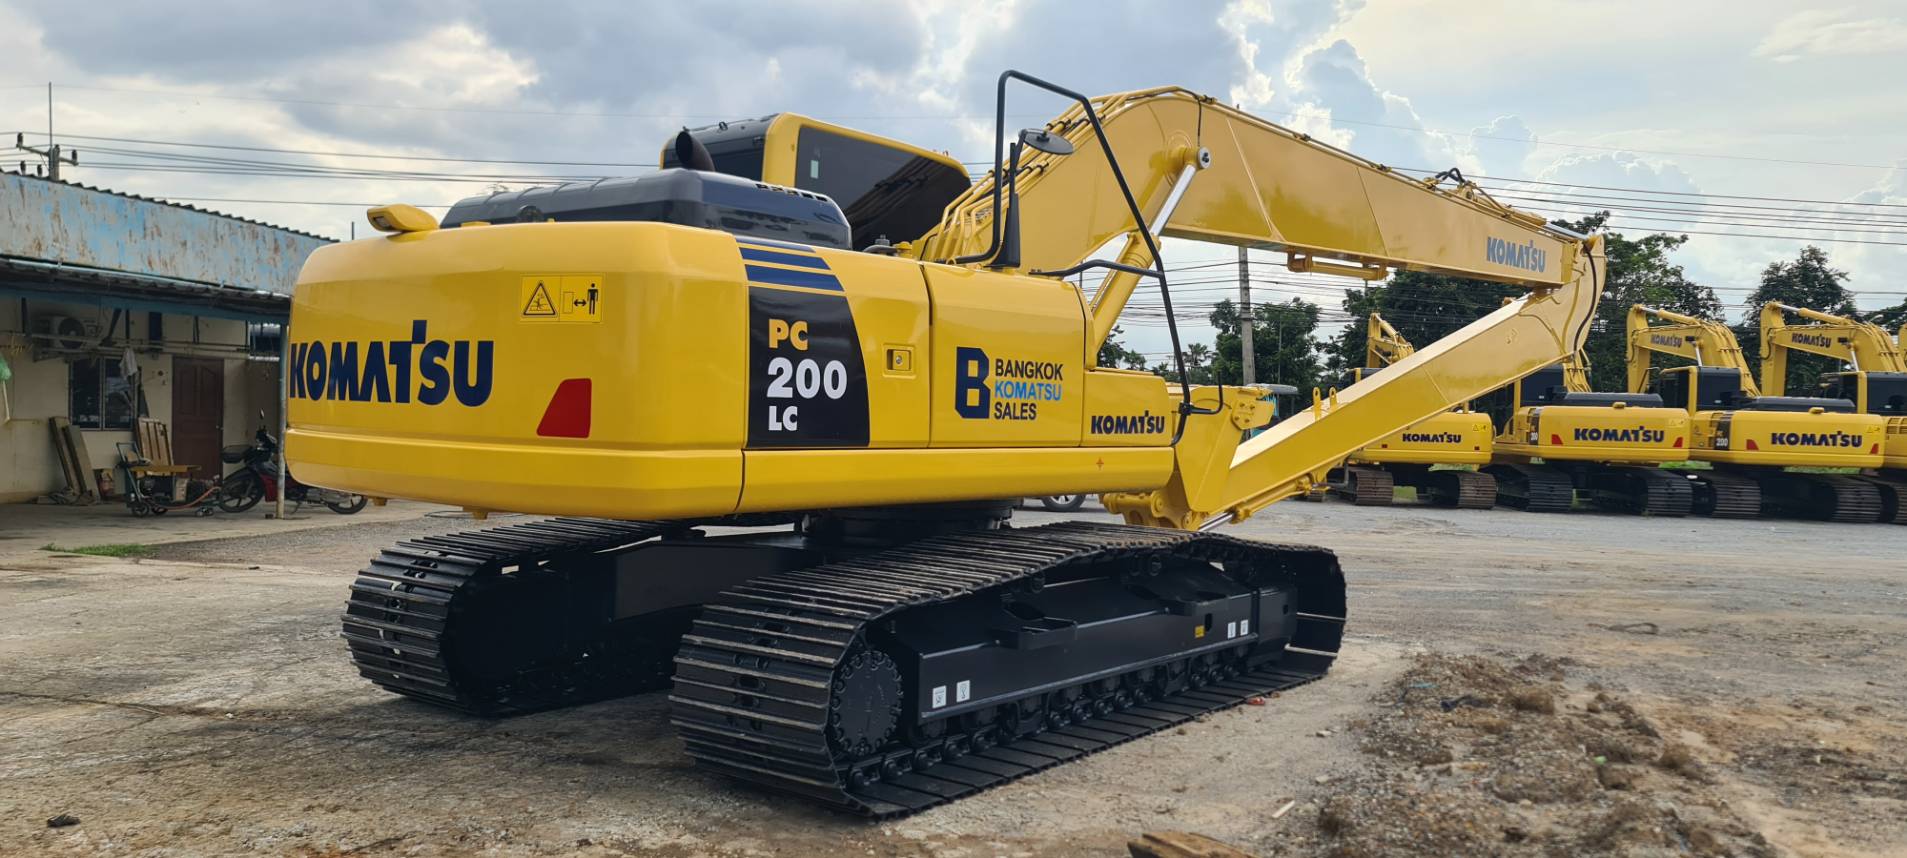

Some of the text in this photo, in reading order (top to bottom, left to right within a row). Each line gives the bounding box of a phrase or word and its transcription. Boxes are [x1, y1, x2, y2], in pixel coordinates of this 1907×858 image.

[1487, 236, 1546, 272] KOMATSU
[768, 318, 808, 351] PC
[1651, 334, 1682, 348] KOMATSU
[1791, 332, 1831, 348] KOMATSU
[290, 319, 493, 407] KOMATSU
[994, 358, 1063, 381] BANGKOK
[766, 356, 848, 400] 200
[994, 380, 1063, 401] KOMATSU
[767, 405, 798, 432] LC
[993, 401, 1037, 421] SALES
[1090, 409, 1165, 435] KOMATSU
[1402, 431, 1462, 443] KOMATSU
[1574, 425, 1665, 442] KOMATSU
[1716, 437, 1729, 446] 200
[1771, 430, 1862, 447] KOMATSU
